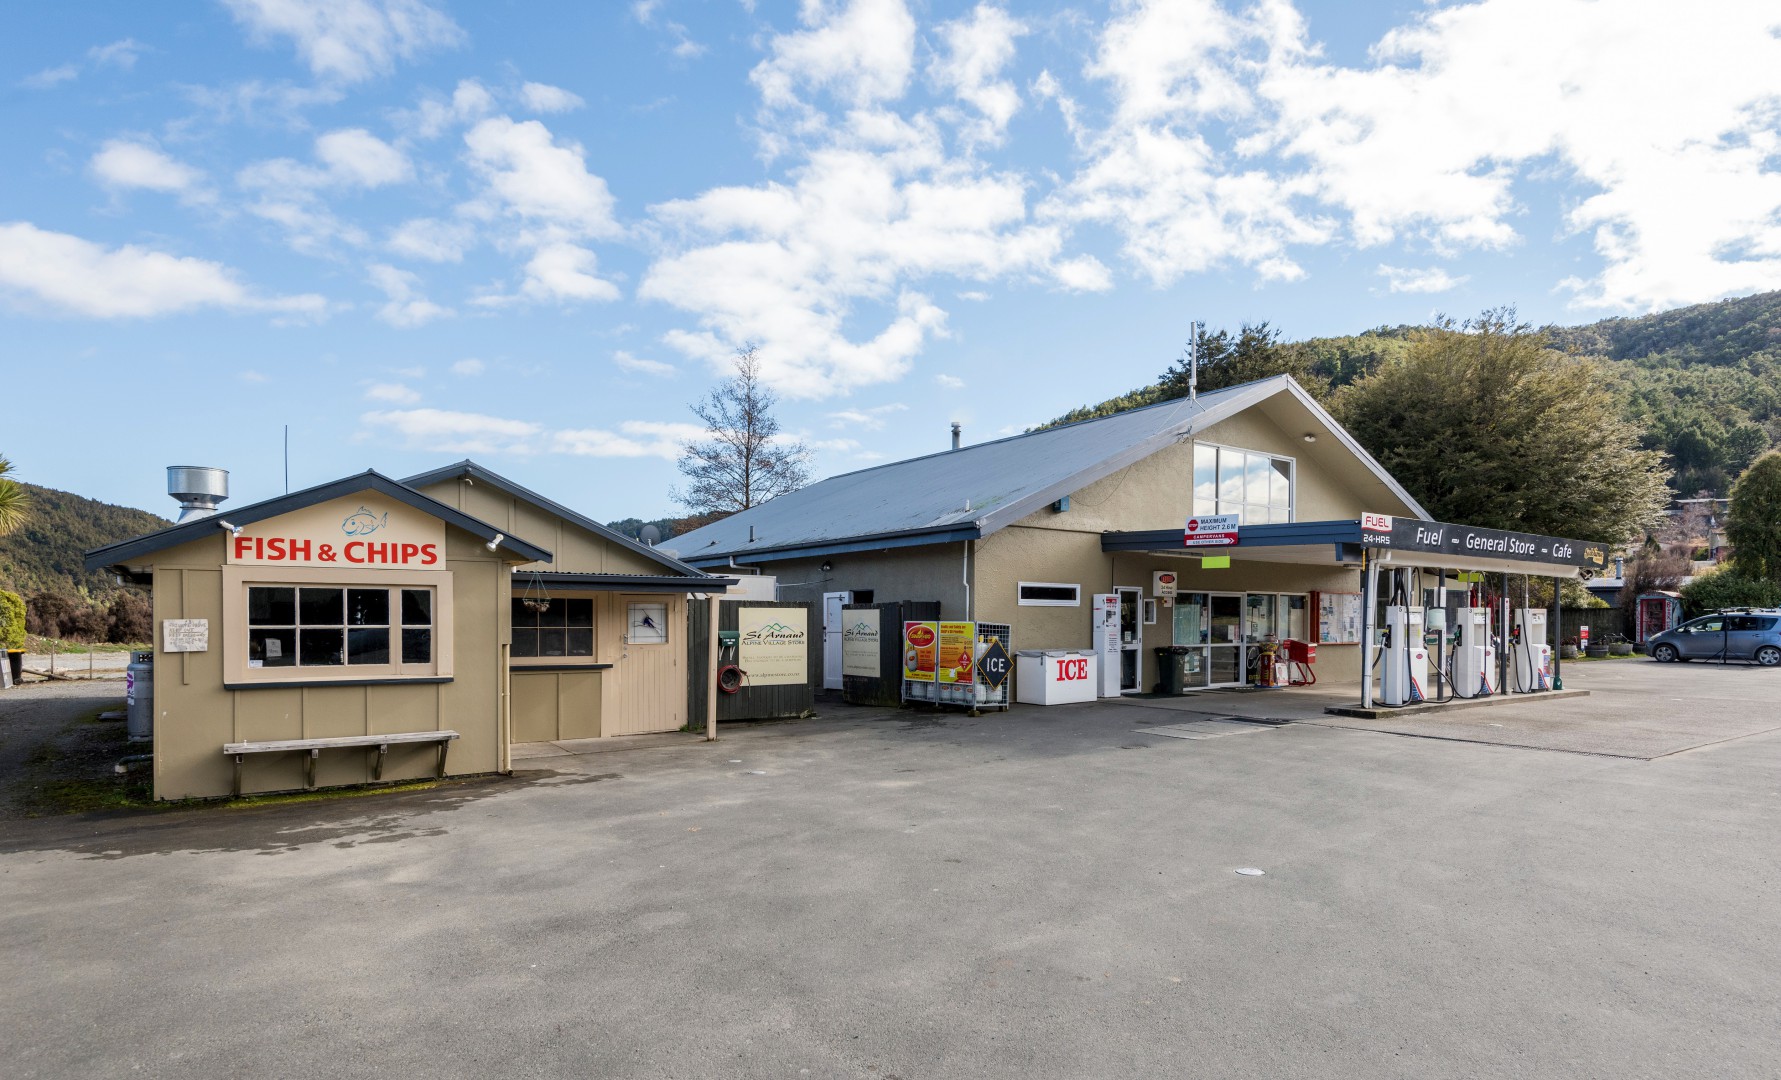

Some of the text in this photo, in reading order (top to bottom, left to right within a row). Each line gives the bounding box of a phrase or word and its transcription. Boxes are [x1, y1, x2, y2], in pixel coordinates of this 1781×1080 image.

[1365, 515, 1389, 528] FUEL
[1363, 533, 1391, 545] 24-HRS
[1416, 526, 1443, 546] Fuel
[1466, 533, 1508, 553] General
[1509, 538, 1535, 556] Store
[1552, 543, 1572, 559] Cafe
[234, 536, 438, 565] FISH & CHIPS
[742, 631, 804, 640] St Arnaud
[986, 657, 1006, 673] ICE
[1056, 658, 1088, 682] ICE
